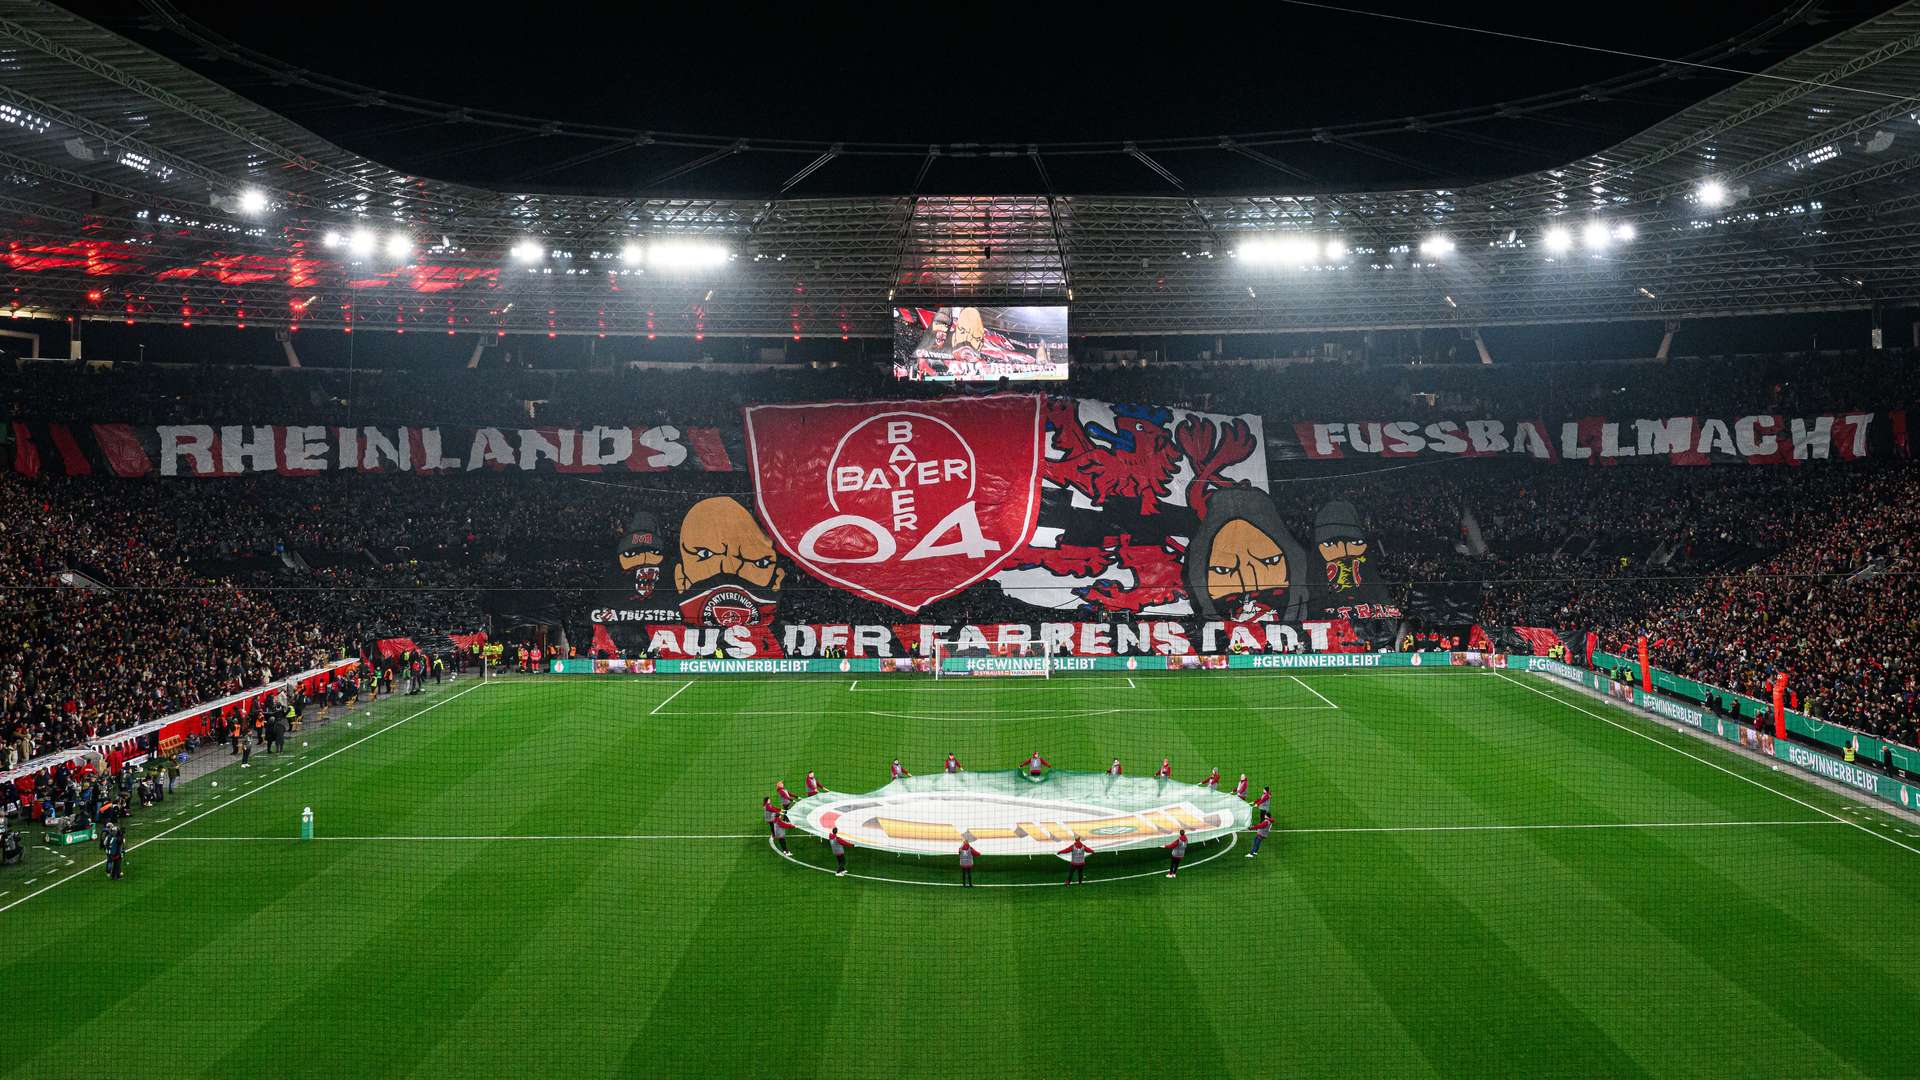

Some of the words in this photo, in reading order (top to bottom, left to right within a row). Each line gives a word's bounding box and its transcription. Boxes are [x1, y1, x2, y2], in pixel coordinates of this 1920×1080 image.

[156, 424, 688, 476] RHEINLANDS
[1313, 412, 1875, 460] FUSSBALLMACHT
[836, 458, 969, 493] BAYER
[887, 420, 919, 532] BAYER
[798, 500, 1001, 564] 04
[647, 624, 757, 659] AUS
[1253, 655, 1381, 668] #GEWINNERBLEIBT
[680, 660, 810, 673] #GEWINNERBLEIBT
[1643, 694, 1703, 728] #GEWINNERBLEIBT
[1788, 746, 1879, 793] #GEWINNERBLEIBT
